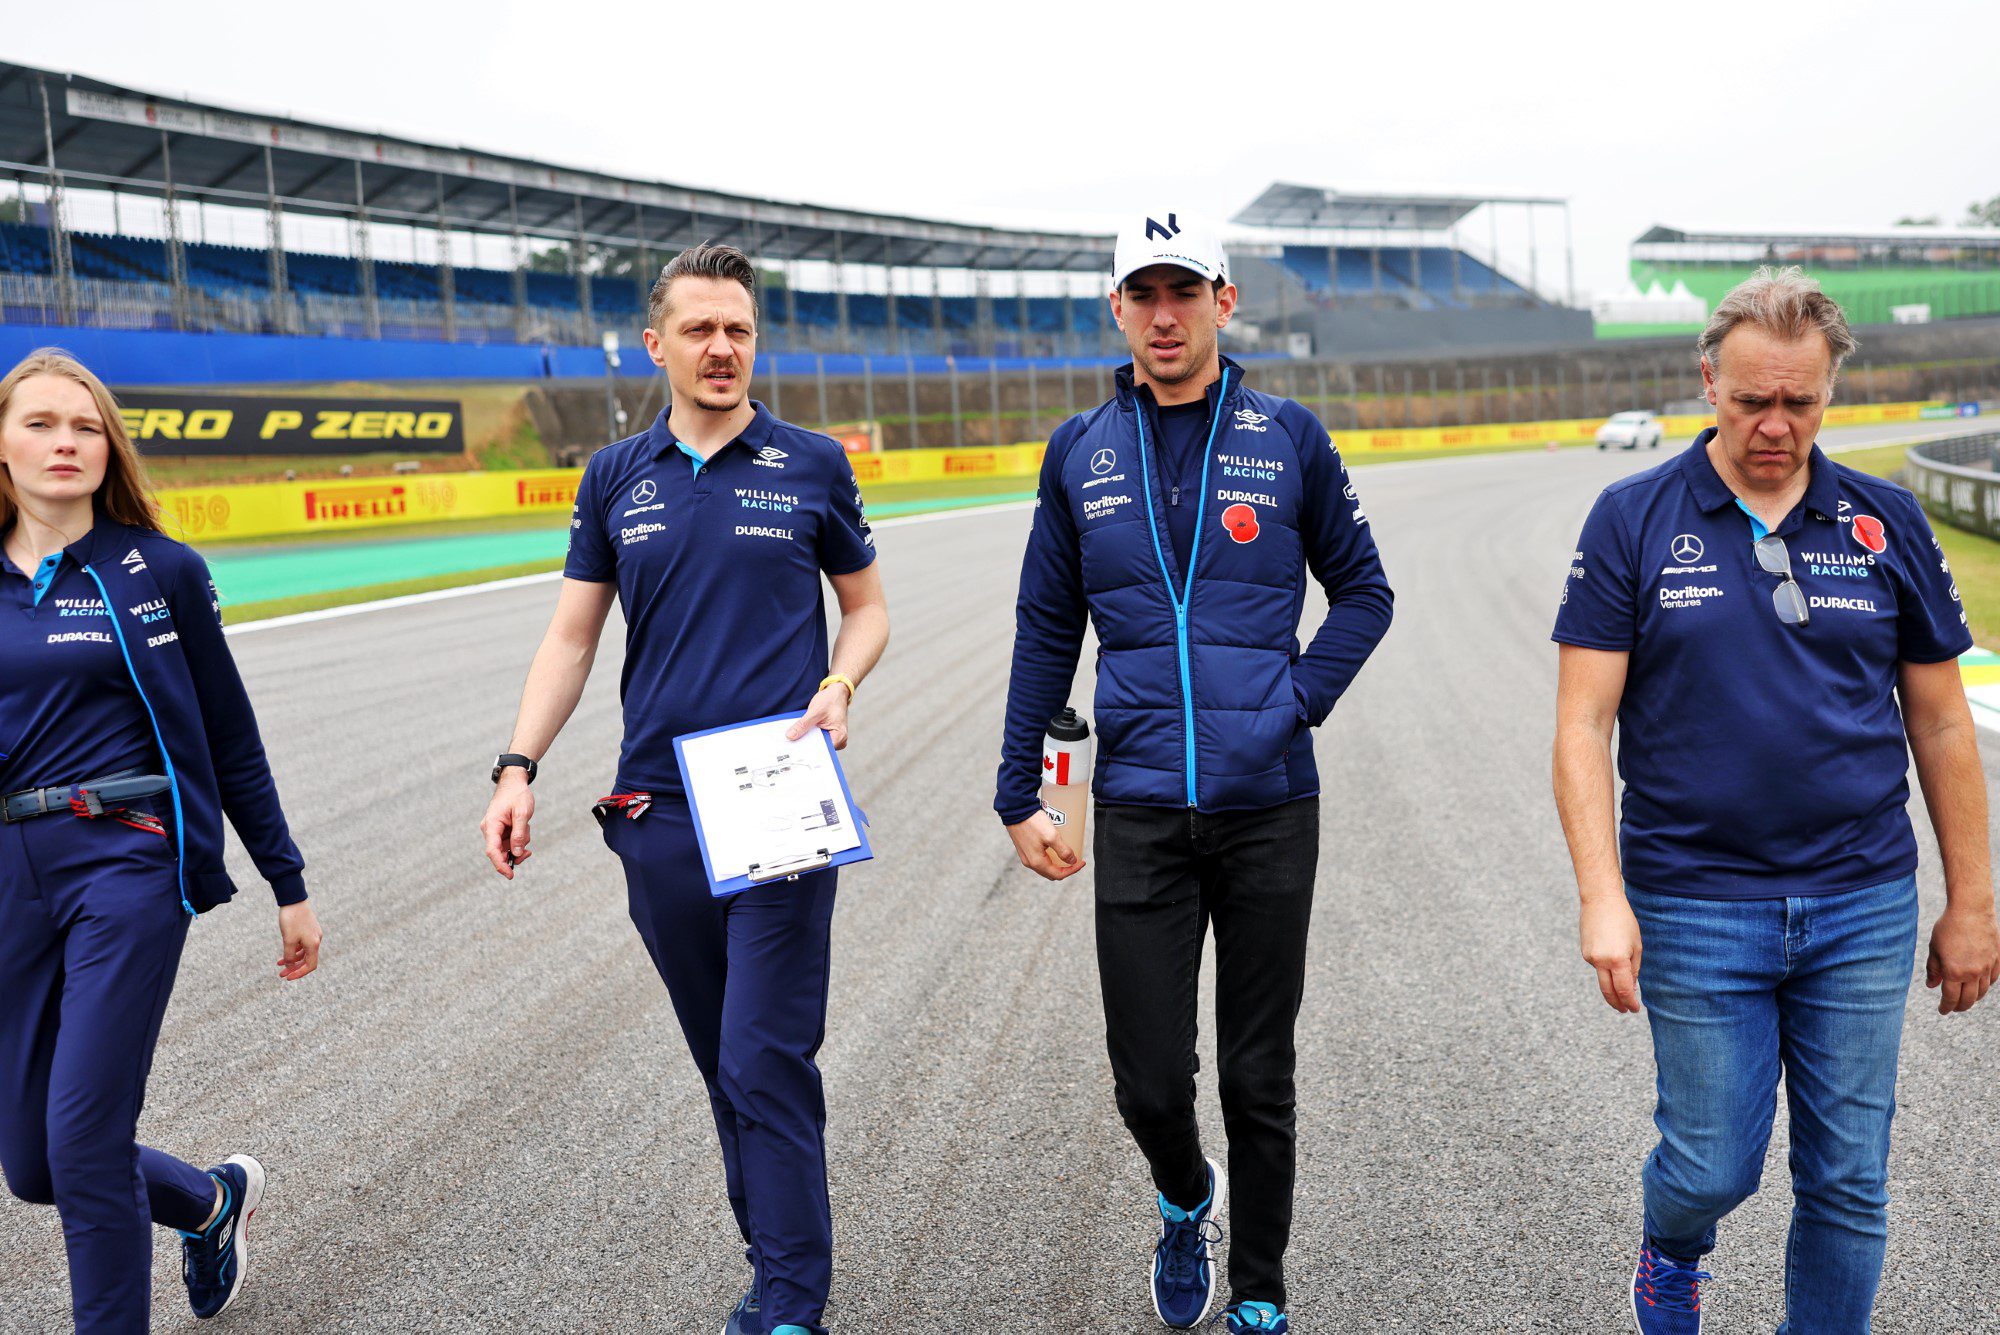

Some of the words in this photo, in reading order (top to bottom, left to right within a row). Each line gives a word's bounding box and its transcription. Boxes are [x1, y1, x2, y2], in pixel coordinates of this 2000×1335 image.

[118, 408, 234, 440] ERO
[259, 410, 304, 440] P
[310, 411, 453, 440] ZERO
[1234, 423, 1268, 433] umbro
[752, 458, 785, 469] umbro
[1217, 454, 1284, 471] WILLIAMS
[1223, 466, 1276, 481] RACING
[304, 485, 406, 521] PIRELLI
[734, 488, 799, 506] WILLIAMS
[1217, 489, 1278, 508] DURACELL
[741, 498, 793, 513] RACING
[1085, 507, 1115, 521] Ventures
[734, 525, 794, 541] DURACELL
[1800, 552, 1876, 566] WILLIAMS
[1810, 564, 1869, 577] RACING
[55, 598, 105, 608] WILLIA
[129, 597, 167, 616] WILLI
[1660, 599, 1702, 609] Ventures
[1809, 596, 1877, 613] DURACELL
[141, 607, 171, 625] RACI
[47, 631, 113, 644] DURACELL
[147, 631, 179, 648] DURA
